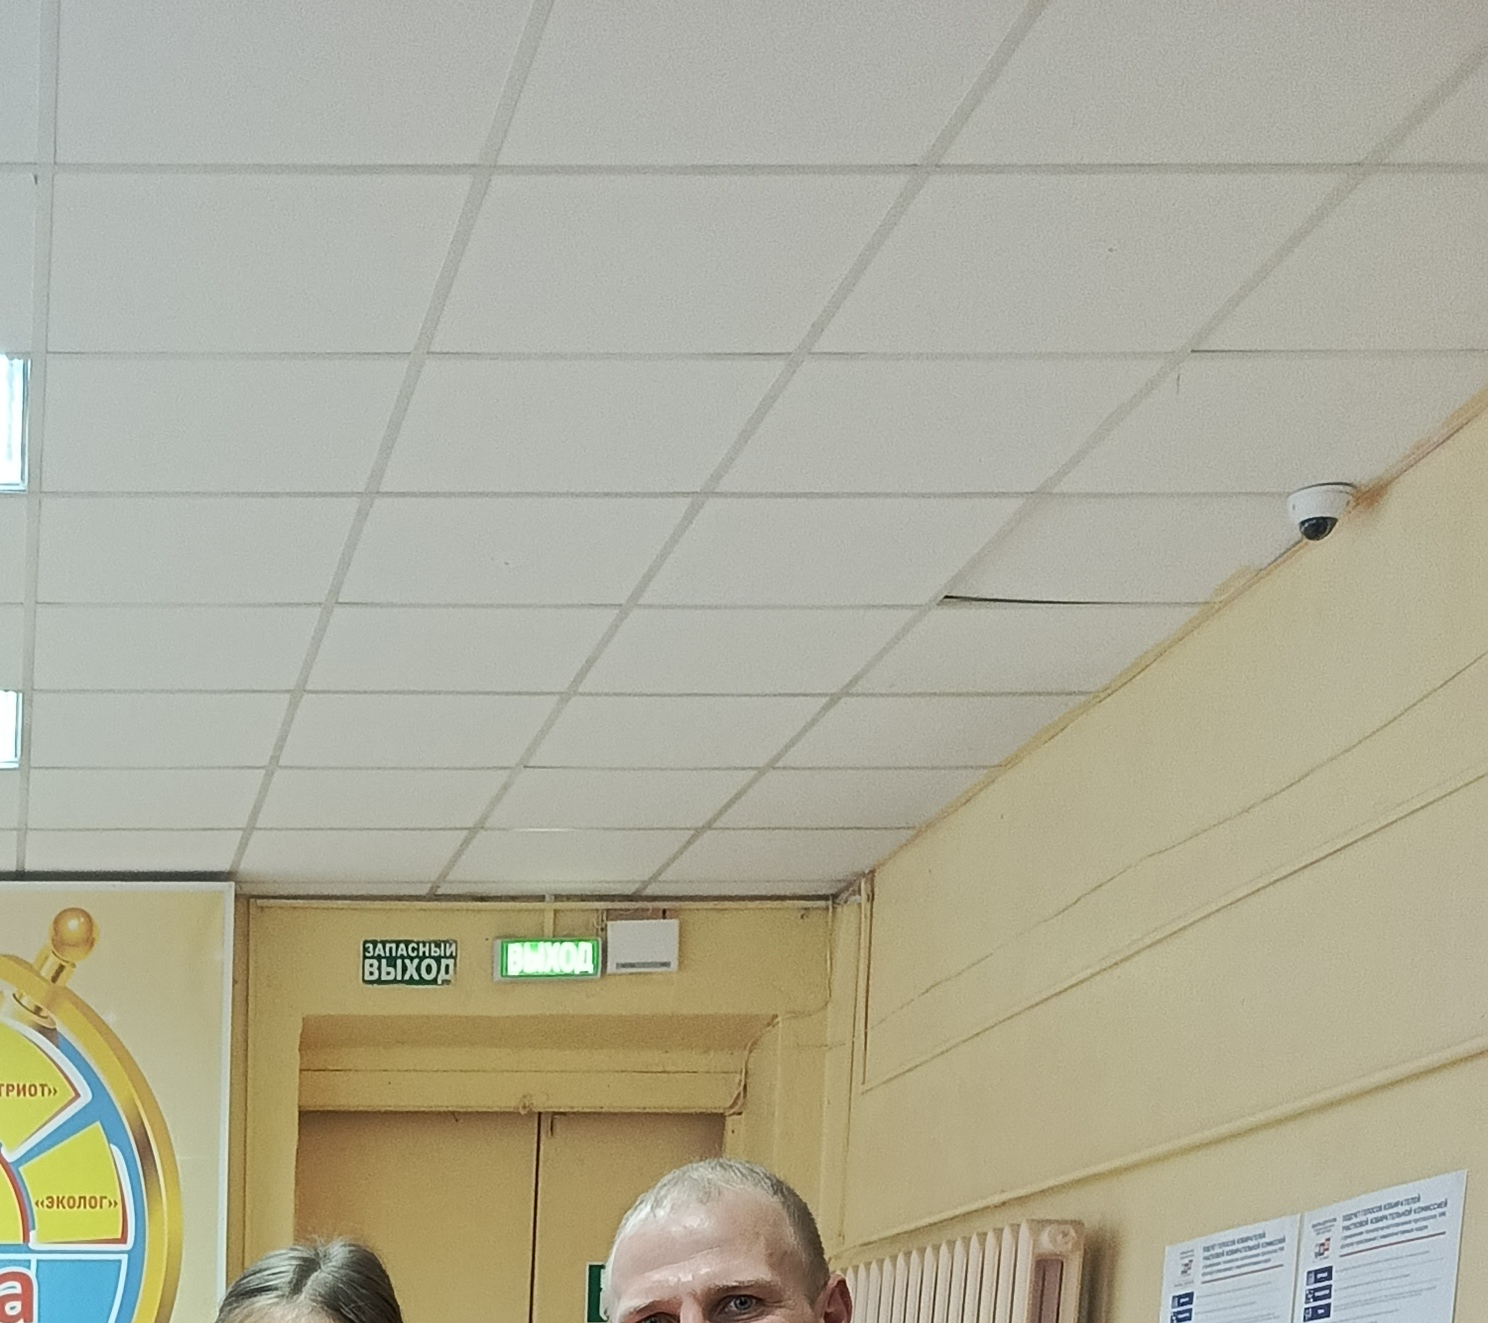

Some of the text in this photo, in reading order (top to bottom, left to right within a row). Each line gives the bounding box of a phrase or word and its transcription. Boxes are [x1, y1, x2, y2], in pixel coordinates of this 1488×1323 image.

[364, 941, 456, 957] ЗАПАСНЫЙ
[508, 941, 594, 975] ВЫХОД
[364, 958, 455, 985] ВЫХОД
